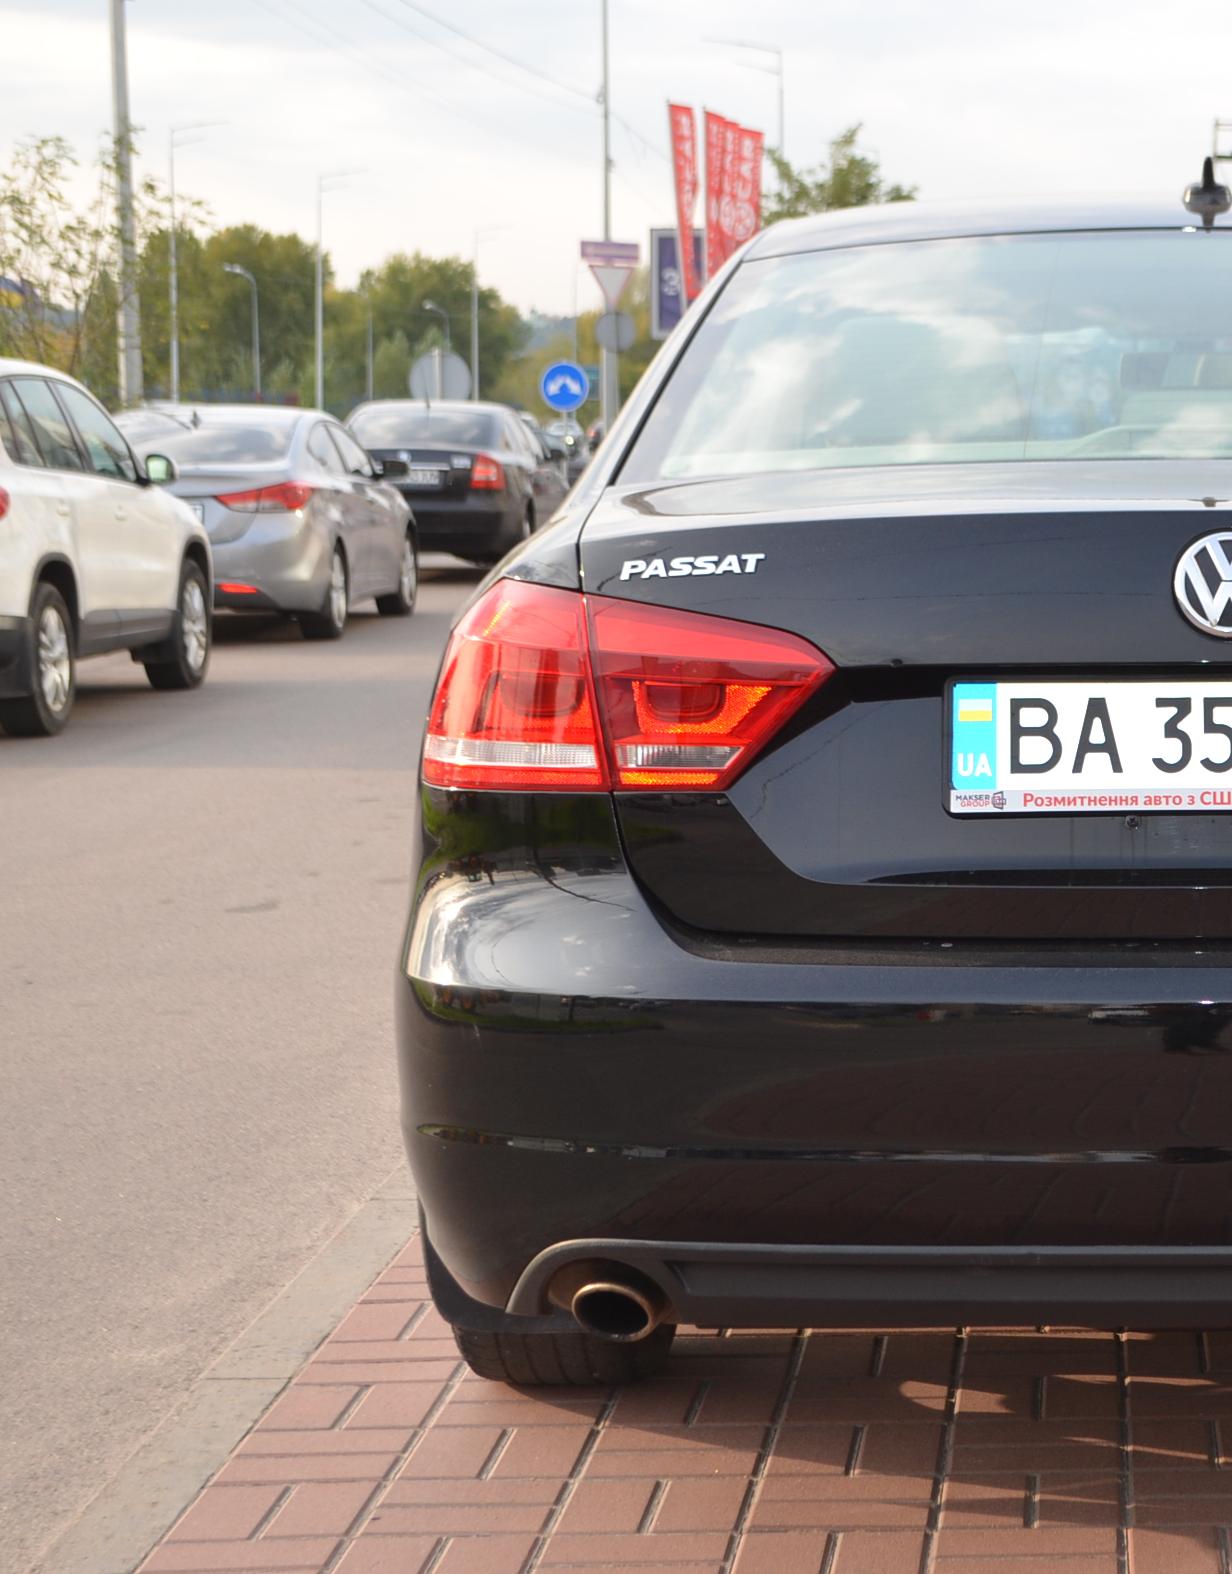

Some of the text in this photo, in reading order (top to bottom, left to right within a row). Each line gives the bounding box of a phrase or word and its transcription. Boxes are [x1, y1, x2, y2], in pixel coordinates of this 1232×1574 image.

[619, 553, 766, 581] PASSAT
[1009, 697, 1124, 774] BA
[957, 752, 993, 777] UA
[960, 800, 991, 808] GROUP
[1022, 792, 1139, 807] Розмитнення
[1143, 795, 1183, 807] авто
[1187, 795, 1196, 806] з
